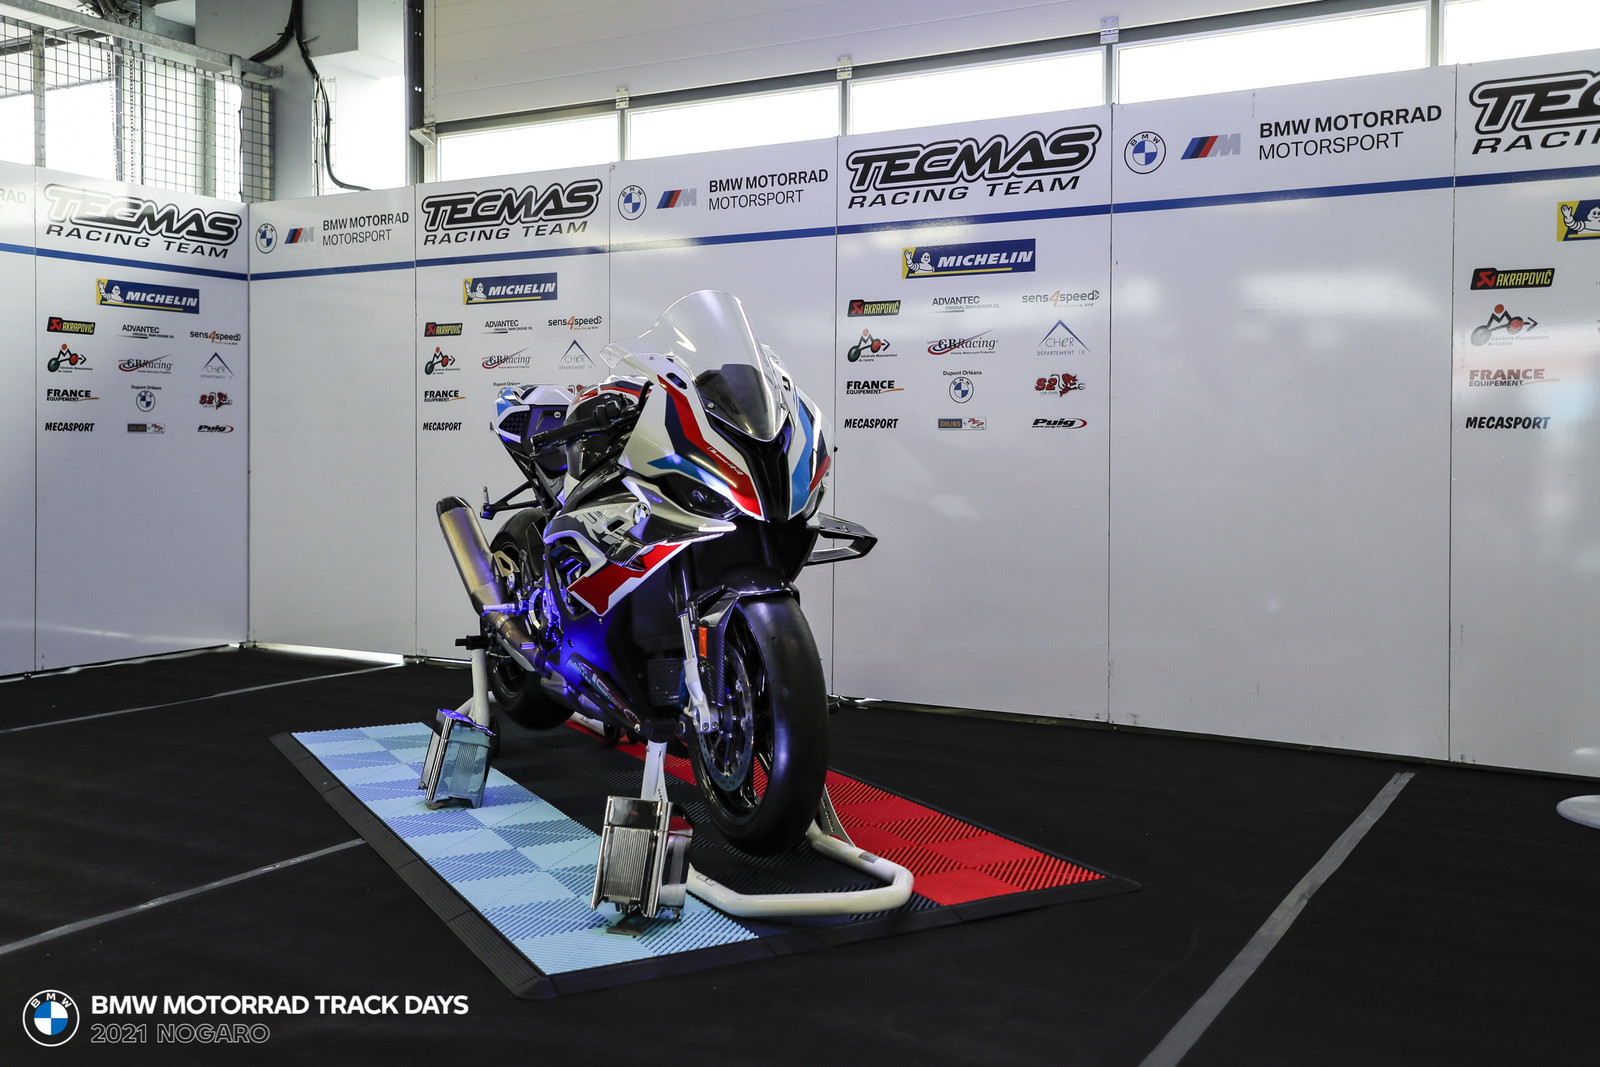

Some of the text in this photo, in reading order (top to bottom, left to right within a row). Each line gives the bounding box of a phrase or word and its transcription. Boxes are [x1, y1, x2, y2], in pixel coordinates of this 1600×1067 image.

[1260, 105, 1442, 138] BMW MOTORRAD
[1259, 131, 1404, 160] MOTORSPORT
[846, 124, 1102, 193] TECMAS
[709, 169, 829, 193] BMW MOTORRAD
[708, 189, 804, 211] MOTORSPORT
[848, 176, 1080, 209] RACING TEAM
[422, 178, 603, 232] TECMAS
[43, 183, 242, 246] TECMAS
[323, 212, 409, 231] BMW MOTORRAD
[322, 229, 392, 246] MOTORSPORT
[423, 220, 588, 246] RACING TEAM
[46, 224, 229, 259] RACING TEAM
[937, 250, 1033, 268] MICHELIN
[488, 282, 556, 296] MICHELIN
[125, 291, 198, 307] MICHELIN
[932, 295, 980, 306] ADVANTEC
[122, 324, 160, 334] ADVANTEC
[485, 320, 519, 328] ADVANTEC
[548, 315, 601, 330] sens4speed
[1469, 369, 1545, 380] FRANCE
[846, 380, 895, 390] FRANCE
[1035, 377, 1058, 391] S2
[47, 388, 92, 398] FRANCE
[424, 390, 460, 398] FRANCE
[45, 421, 95, 432] MECASPORT
[423, 421, 462, 431] MECASPORT
[844, 418, 899, 429] MECASPORT
[1032, 418, 1076, 427] Puig
[1465, 416, 1551, 430] MECASPORT
